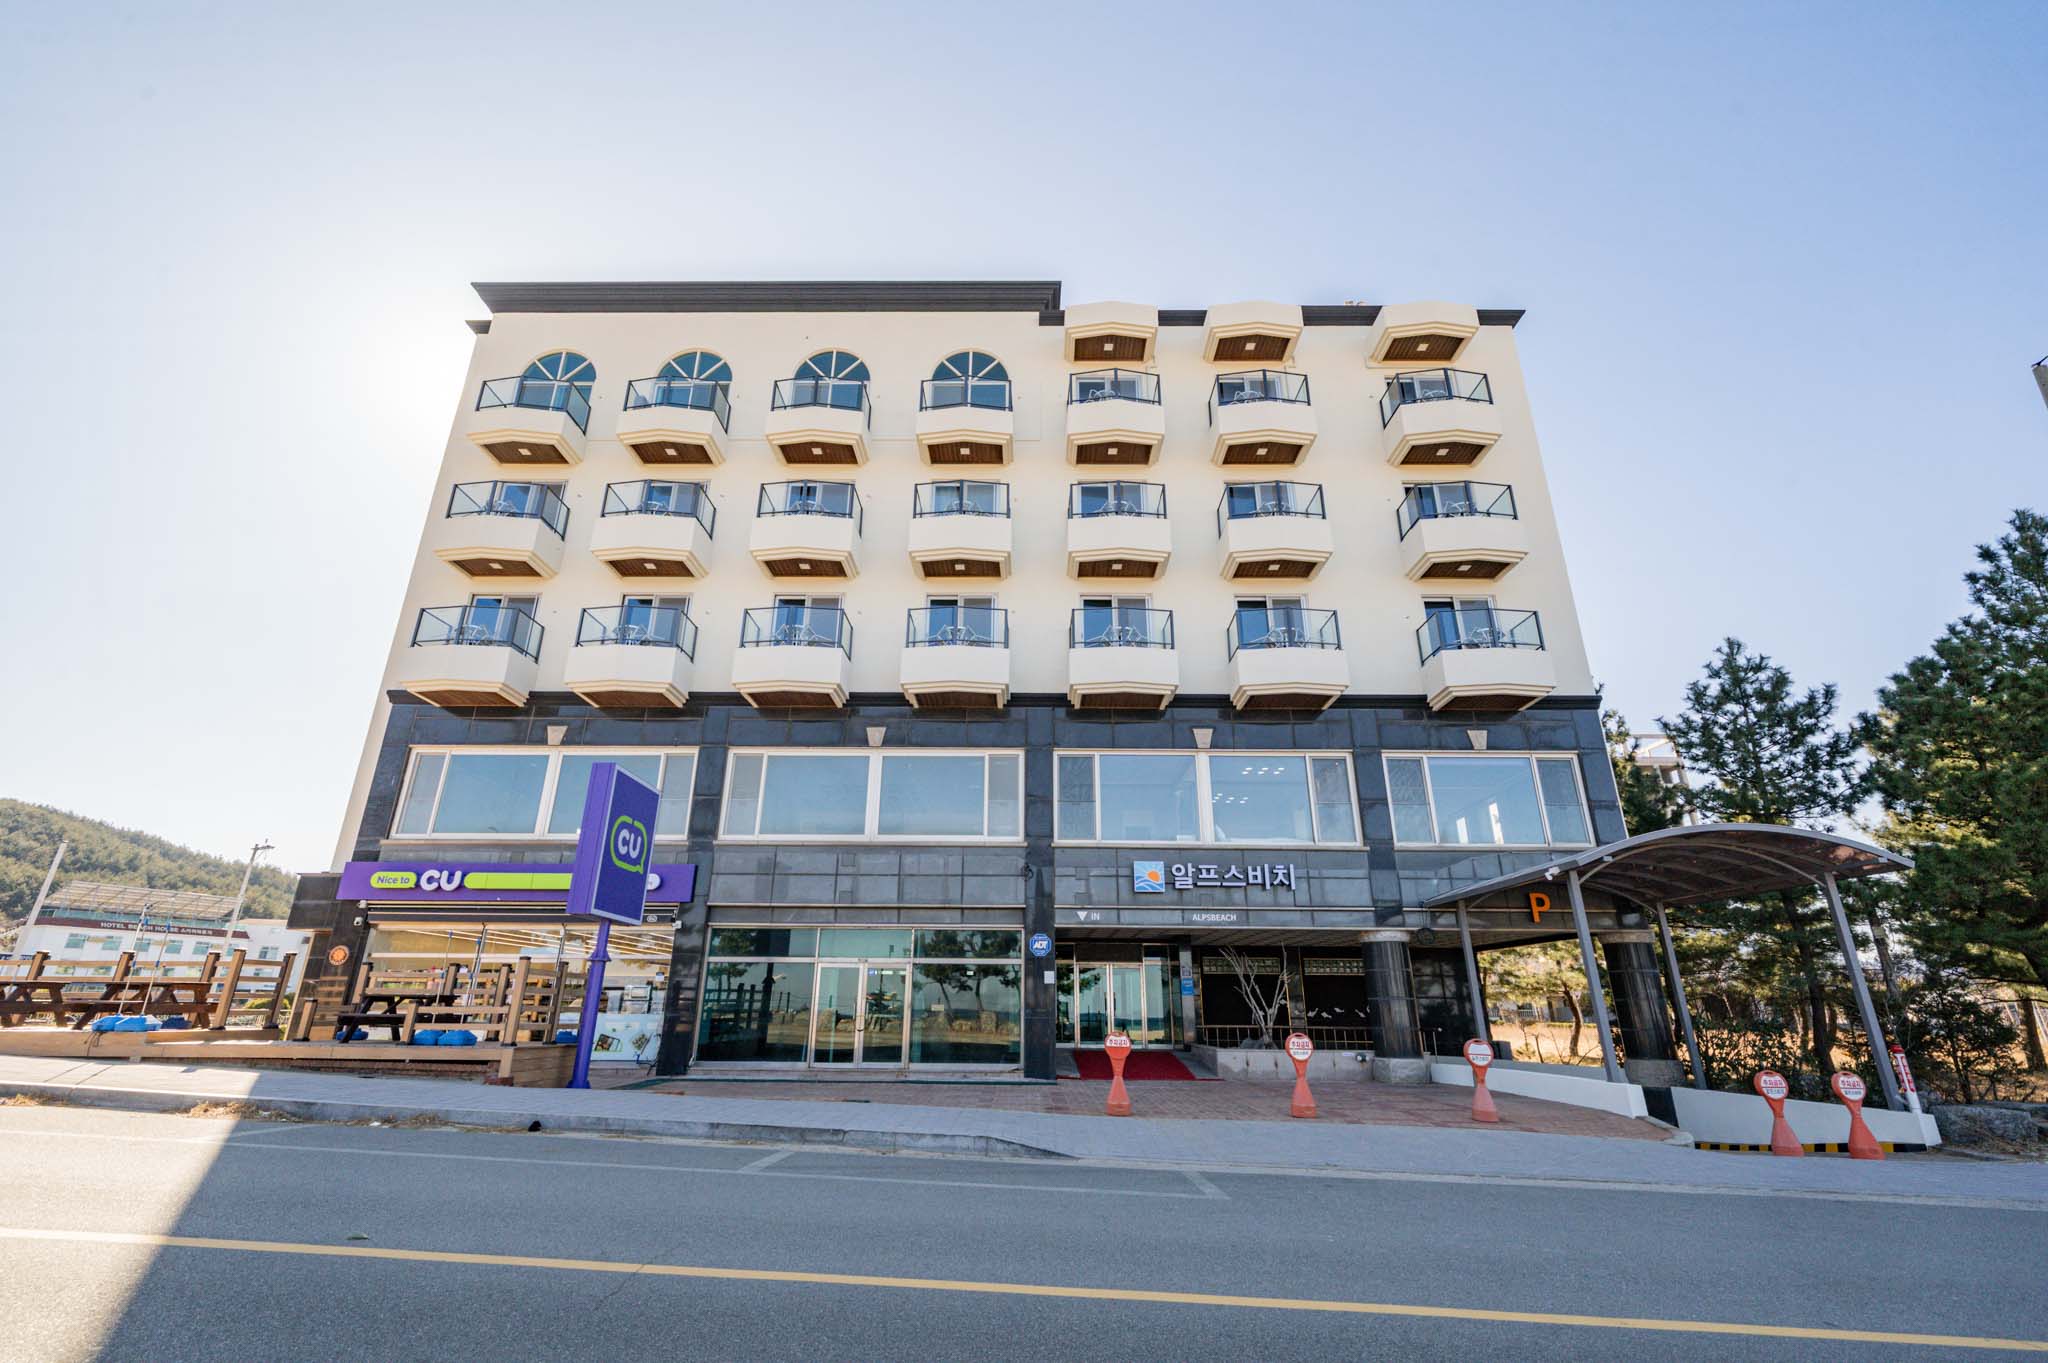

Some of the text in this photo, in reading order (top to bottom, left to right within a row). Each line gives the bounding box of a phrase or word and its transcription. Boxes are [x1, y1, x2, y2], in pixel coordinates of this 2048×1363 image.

[617, 828, 642, 859] CU
[376, 869, 463, 891] Nice to CU
[1171, 862, 1297, 891] 알프스비치
[1529, 892, 1551, 924] P
[1091, 912, 1100, 921] IN
[1192, 913, 1237, 922] ALPSBEACH
[100, 921, 126, 930] HOTEL
[1033, 940, 1048, 949] ADT
